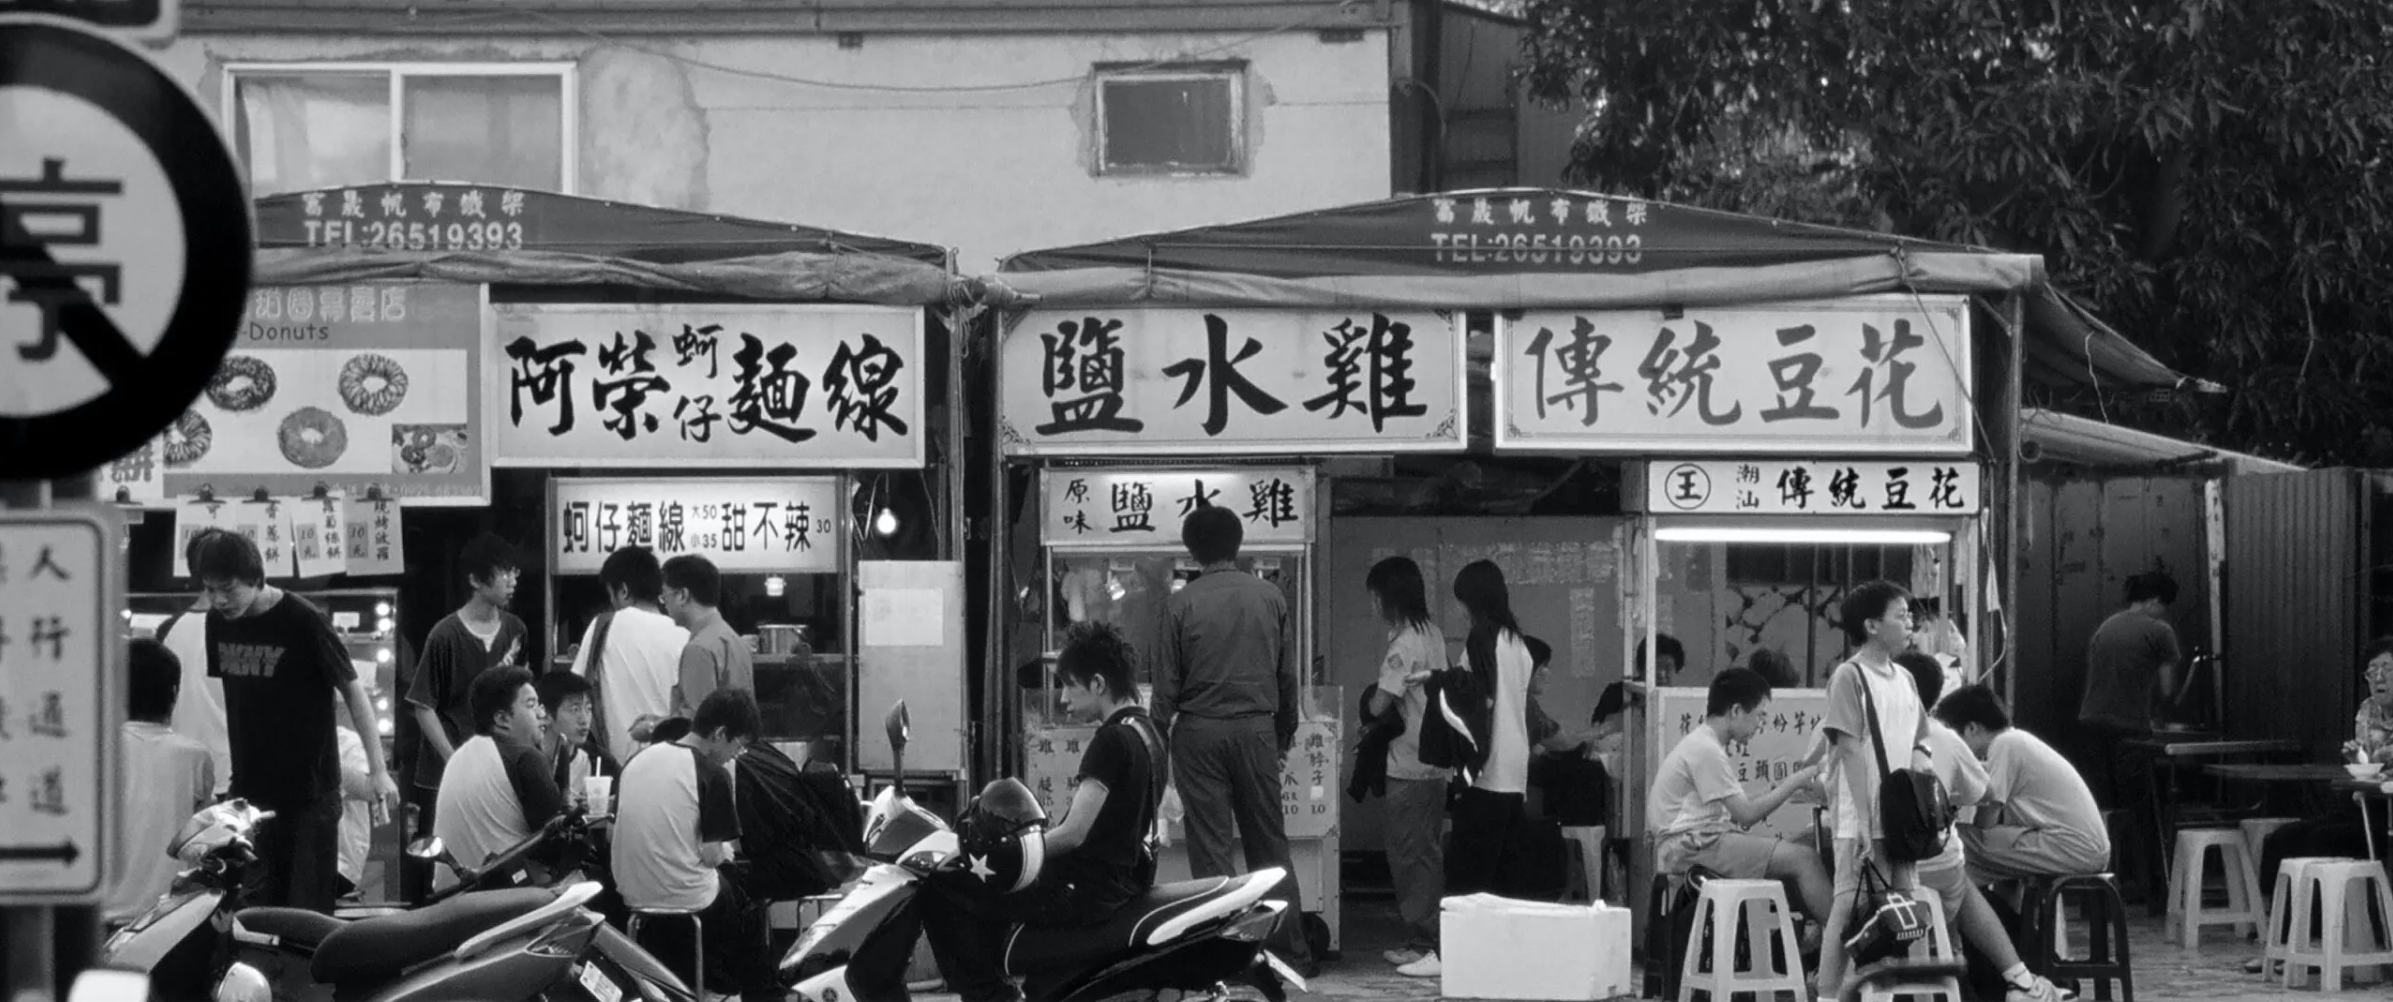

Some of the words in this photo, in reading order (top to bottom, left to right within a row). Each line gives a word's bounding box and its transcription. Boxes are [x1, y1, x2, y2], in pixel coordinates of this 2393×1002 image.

[1431, 233, 1642, 265] TEL:26519393
[1035, 312, 1428, 437] 鹽水雞
[1523, 316, 1944, 429] 傳統豆花
[1063, 478, 1094, 536] 原味
[1775, 467, 1966, 510] 傳統豆花
[301, 527, 315, 540] 10
[351, 526, 366, 539] 10
[563, 500, 686, 553] 蚵仔麵線
[721, 500, 812, 552] 甜不辣
[816, 518, 832, 534] 30
[1283, 804, 1299, 815] 10
[1311, 804, 1326, 815] 10
